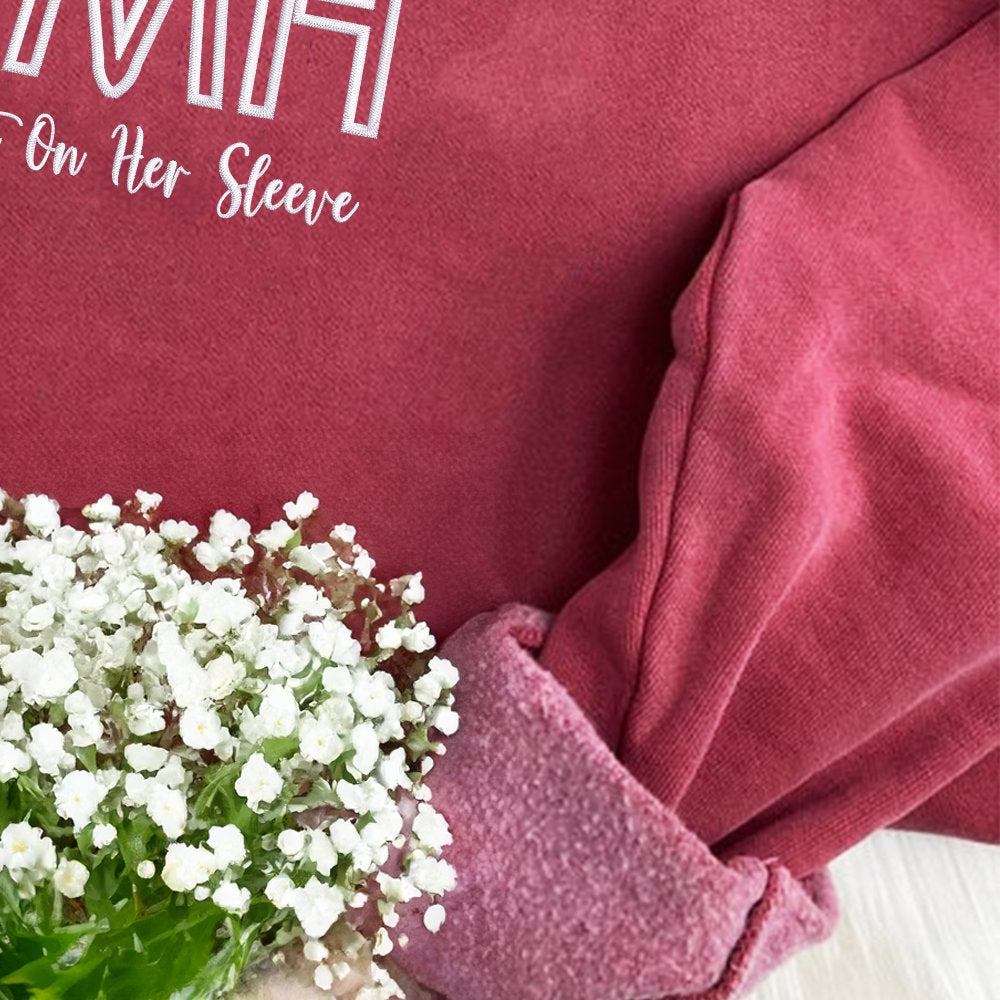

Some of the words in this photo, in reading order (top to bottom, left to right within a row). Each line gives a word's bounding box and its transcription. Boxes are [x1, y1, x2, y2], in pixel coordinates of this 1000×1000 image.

[26, 113, 87, 176] On
[111, 124, 191, 198] Her
[216, 142, 359, 225] Sleeve
